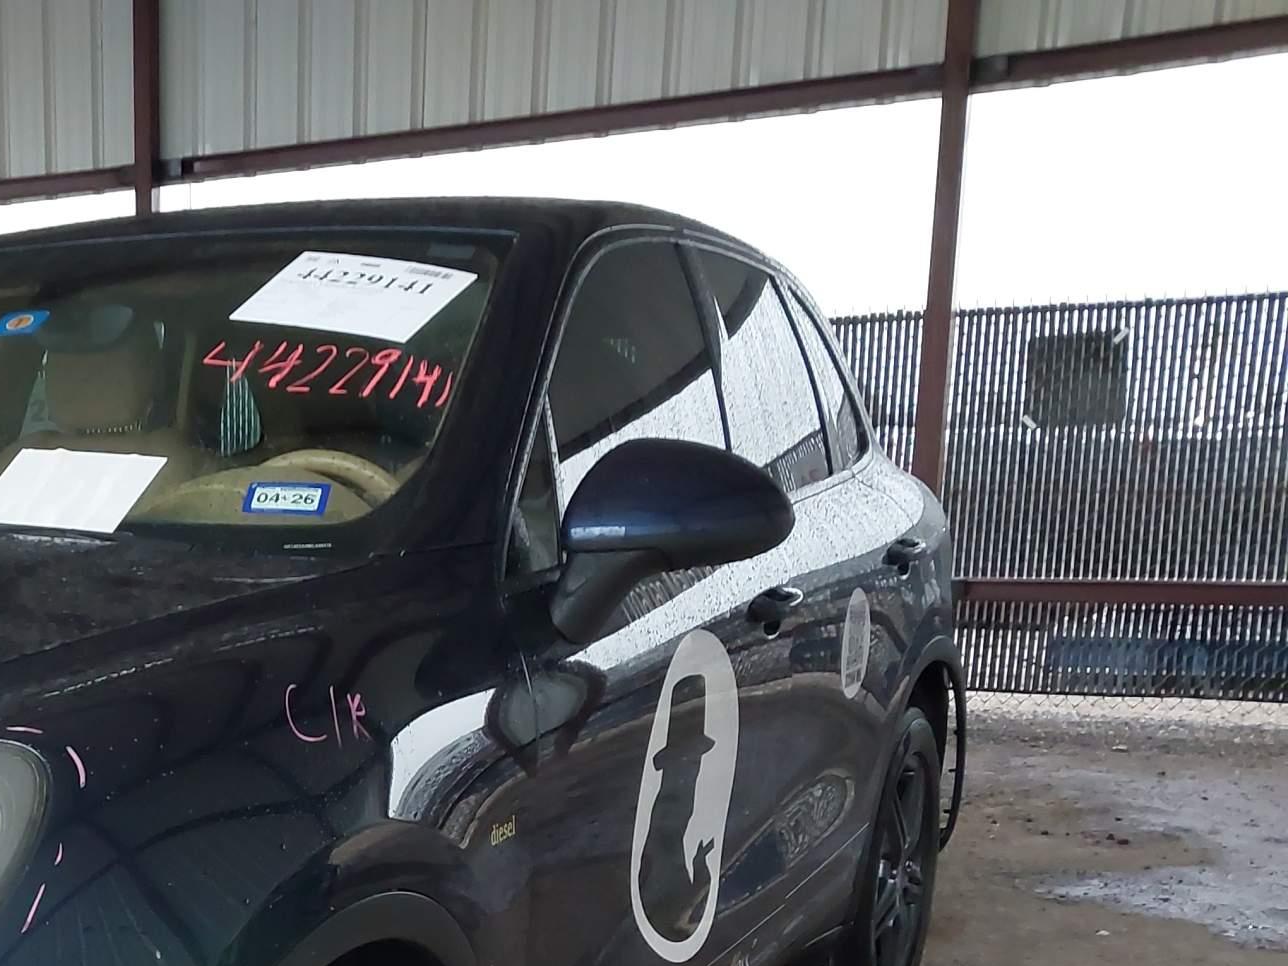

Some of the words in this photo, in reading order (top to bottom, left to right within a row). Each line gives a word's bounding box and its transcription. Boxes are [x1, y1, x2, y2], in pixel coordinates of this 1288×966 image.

[202, 340, 454, 408] 44229141
[256, 492, 280, 504] 04
[290, 493, 316, 505] 26
[490, 815, 516, 846] diesel
